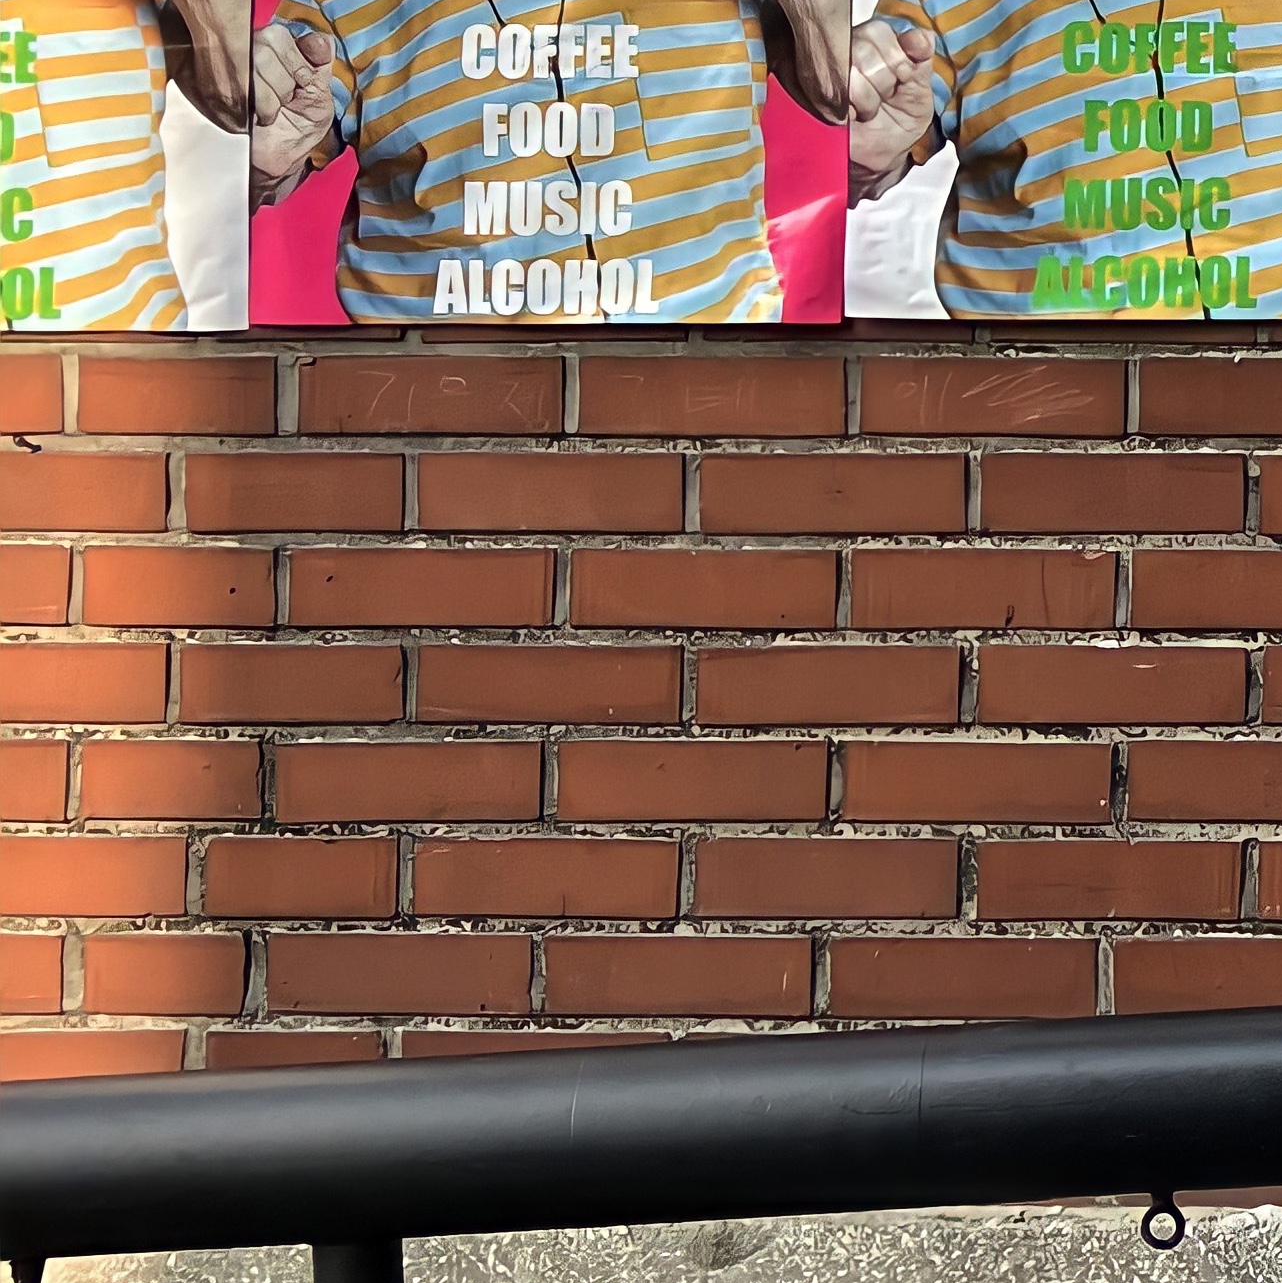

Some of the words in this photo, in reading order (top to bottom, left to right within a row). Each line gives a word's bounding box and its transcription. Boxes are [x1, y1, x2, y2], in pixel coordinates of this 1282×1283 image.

[461, 23, 638, 79] COFFEE
[1062, 21, 1236, 74] COFFEE
[483, 103, 614, 156] FOOD
[1083, 99, 1213, 152] FOOD
[463, 180, 632, 234] MUSIC
[1063, 177, 1230, 232] MUSIC
[432, 260, 659, 315] ALCOHOL
[1031, 256, 1257, 312] ALCOHOL
